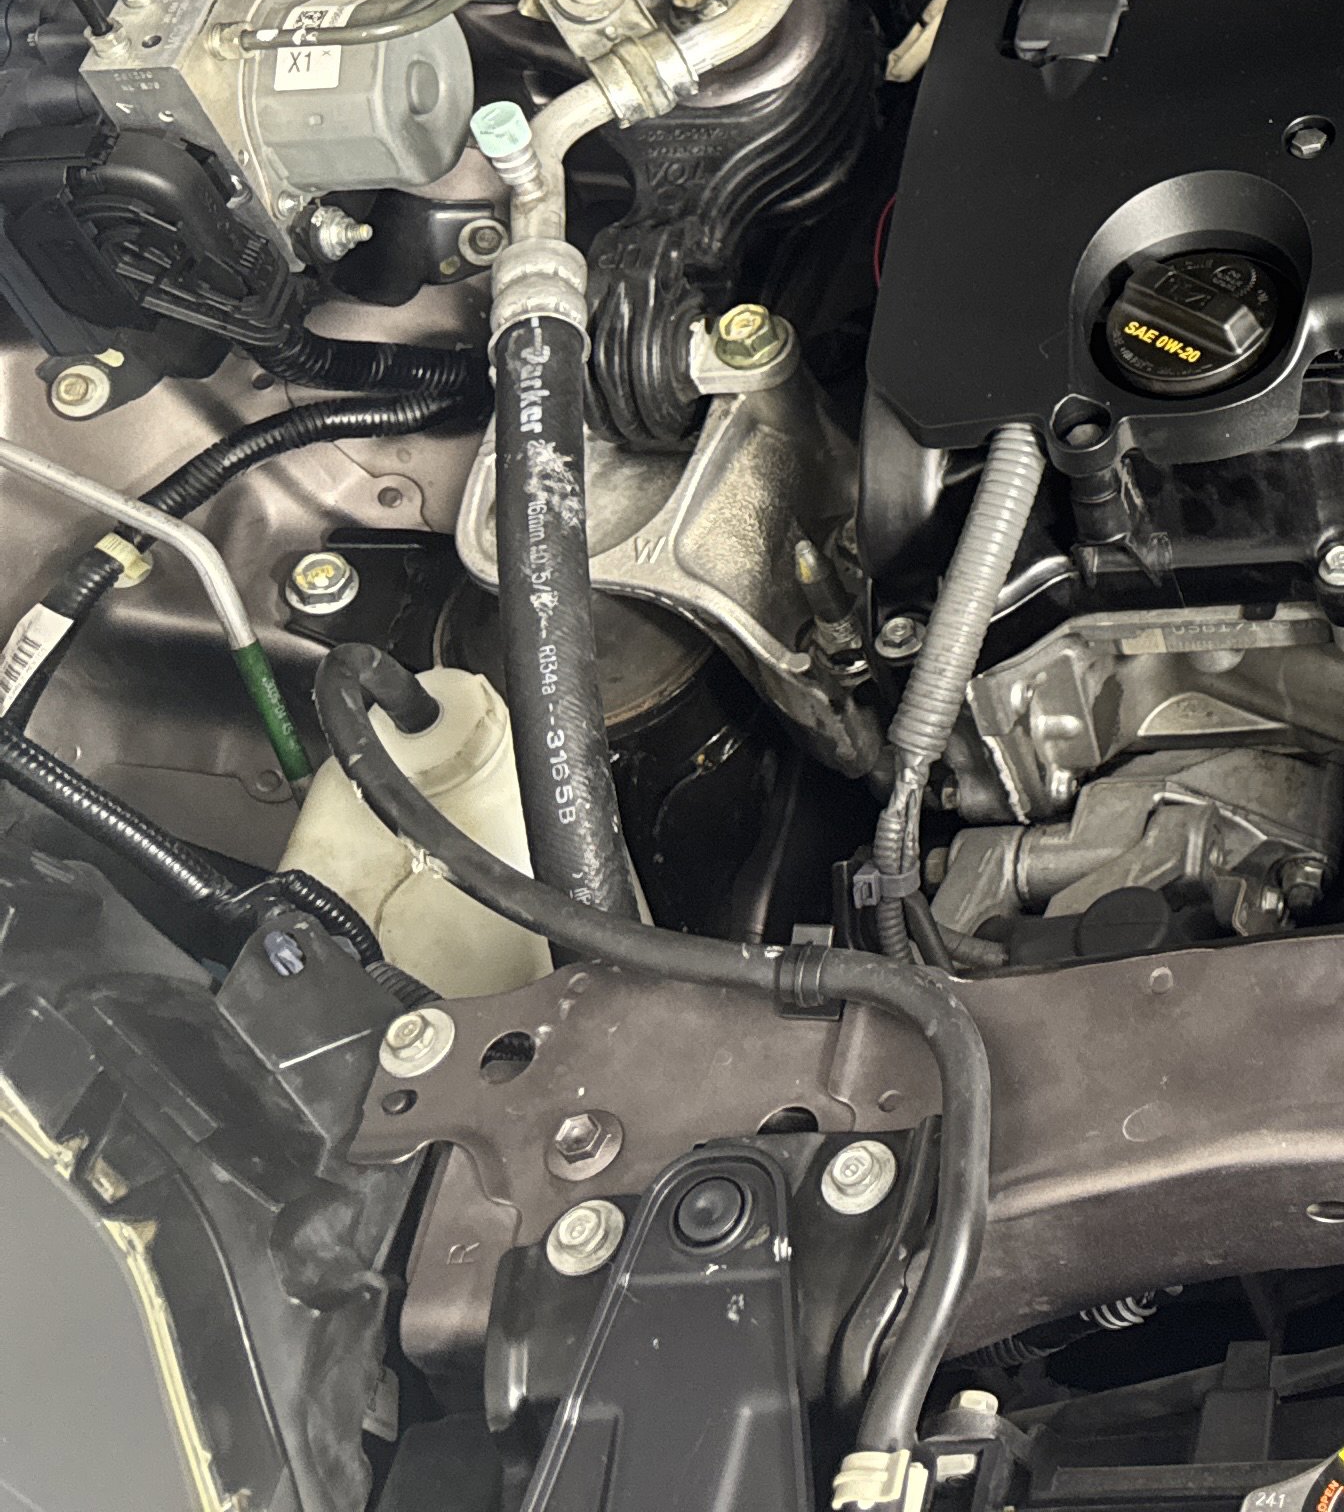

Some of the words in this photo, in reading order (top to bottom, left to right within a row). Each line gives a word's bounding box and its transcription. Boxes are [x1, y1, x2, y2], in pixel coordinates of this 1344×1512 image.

[287, 51, 313, 73] X1
[1124, 321, 1159, 344] SAE
[1155, 335, 1201, 363] 0W-20
[538, 645, 559, 695] R134a
[1255, 1492, 1285, 1509] 241
